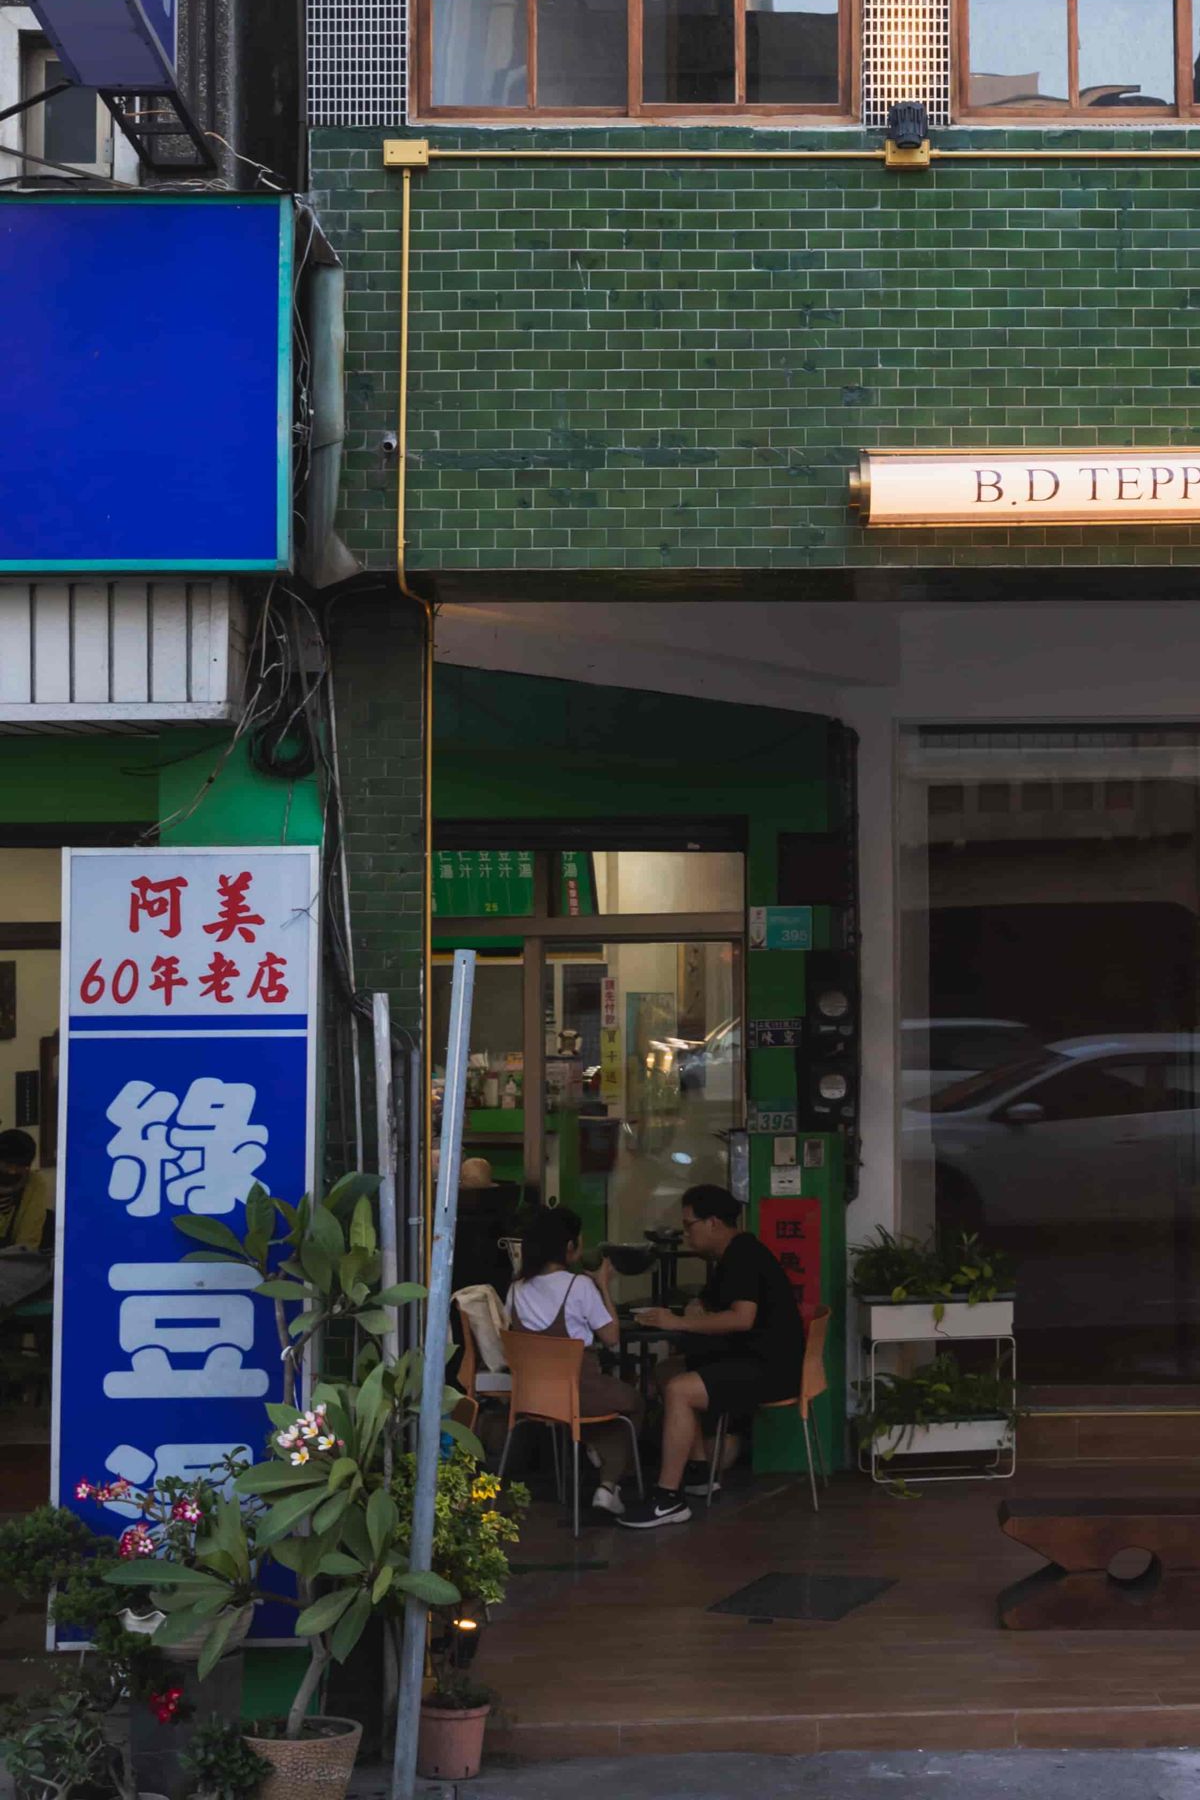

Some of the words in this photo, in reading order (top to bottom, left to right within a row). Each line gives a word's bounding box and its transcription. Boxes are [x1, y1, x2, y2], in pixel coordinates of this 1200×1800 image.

[973, 467, 1061, 506] B.D
[129, 871, 265, 943] 阿美
[781, 929, 808, 942] 395
[80, 952, 289, 1006] 60年老店
[760, 1113, 794, 1130] 395
